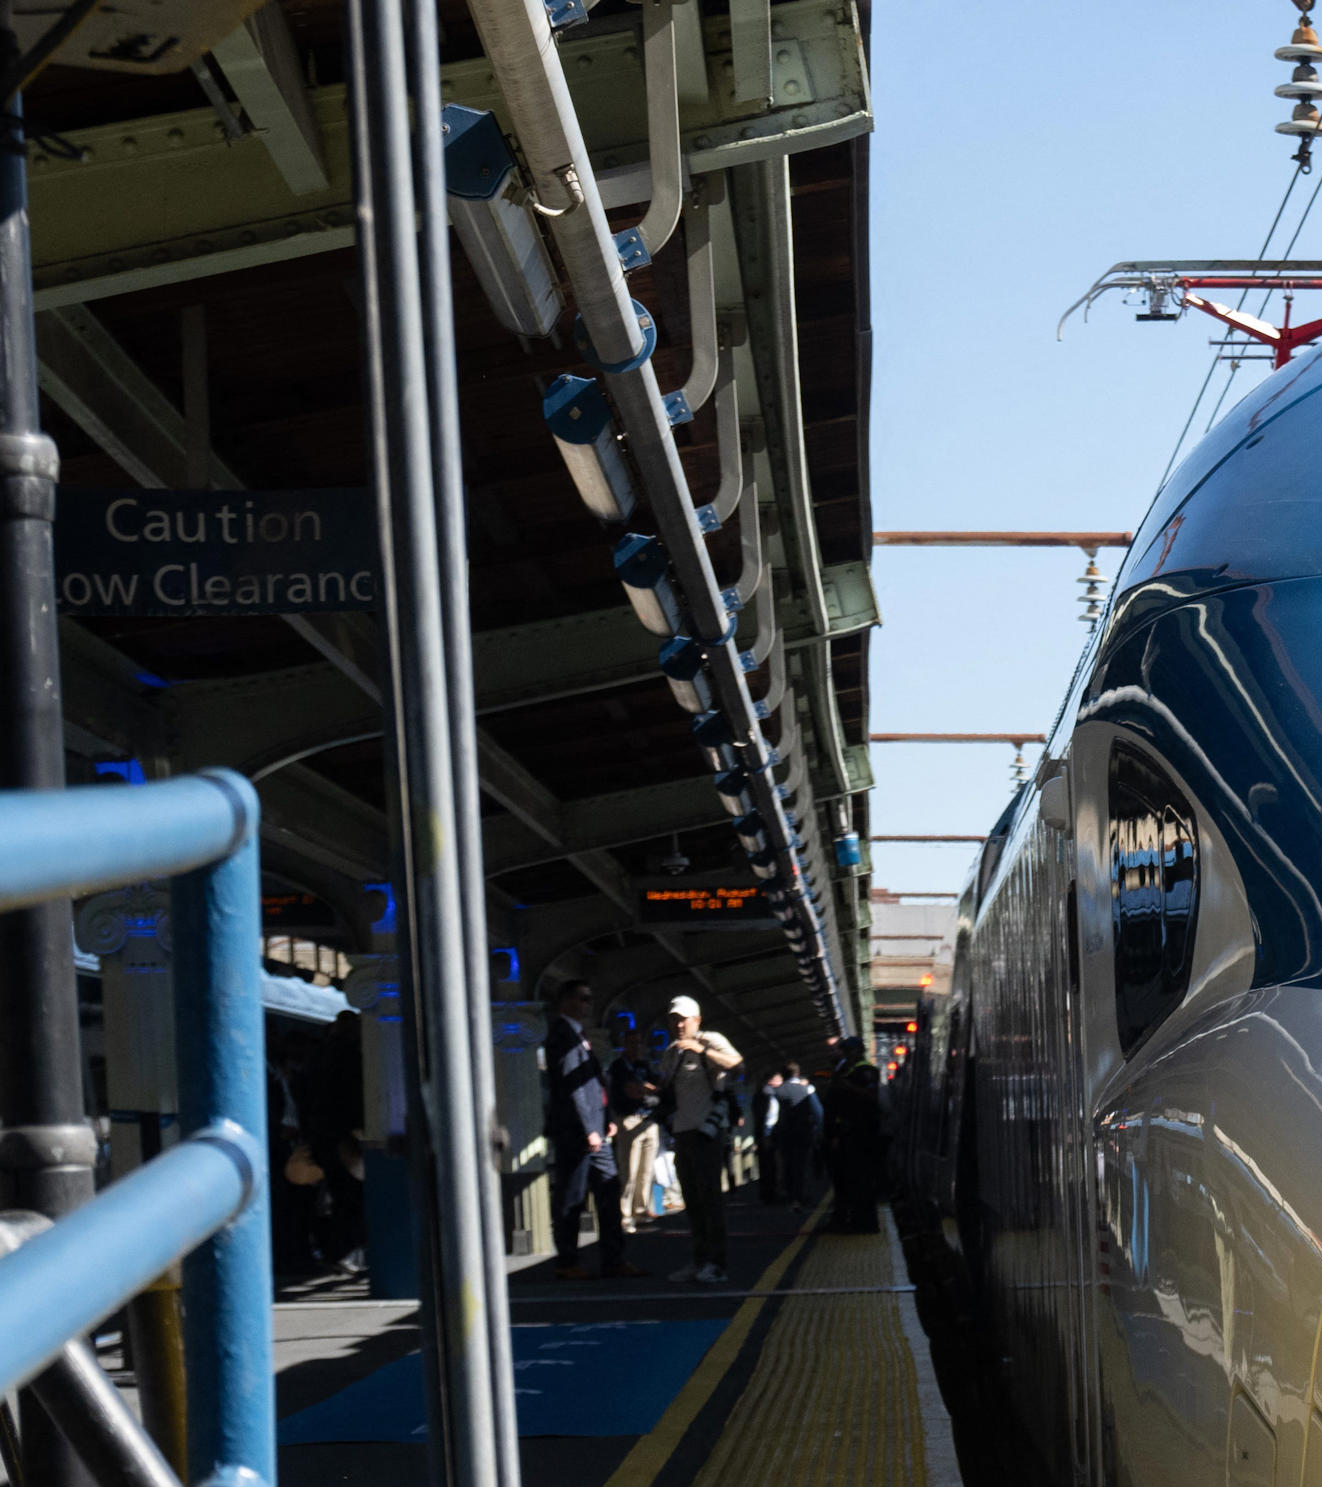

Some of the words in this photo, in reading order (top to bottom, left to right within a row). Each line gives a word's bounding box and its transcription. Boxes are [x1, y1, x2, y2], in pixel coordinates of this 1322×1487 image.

[104, 498, 322, 544] Caution
[56, 572, 139, 606] ow
[153, 562, 376, 606] Clearanc
